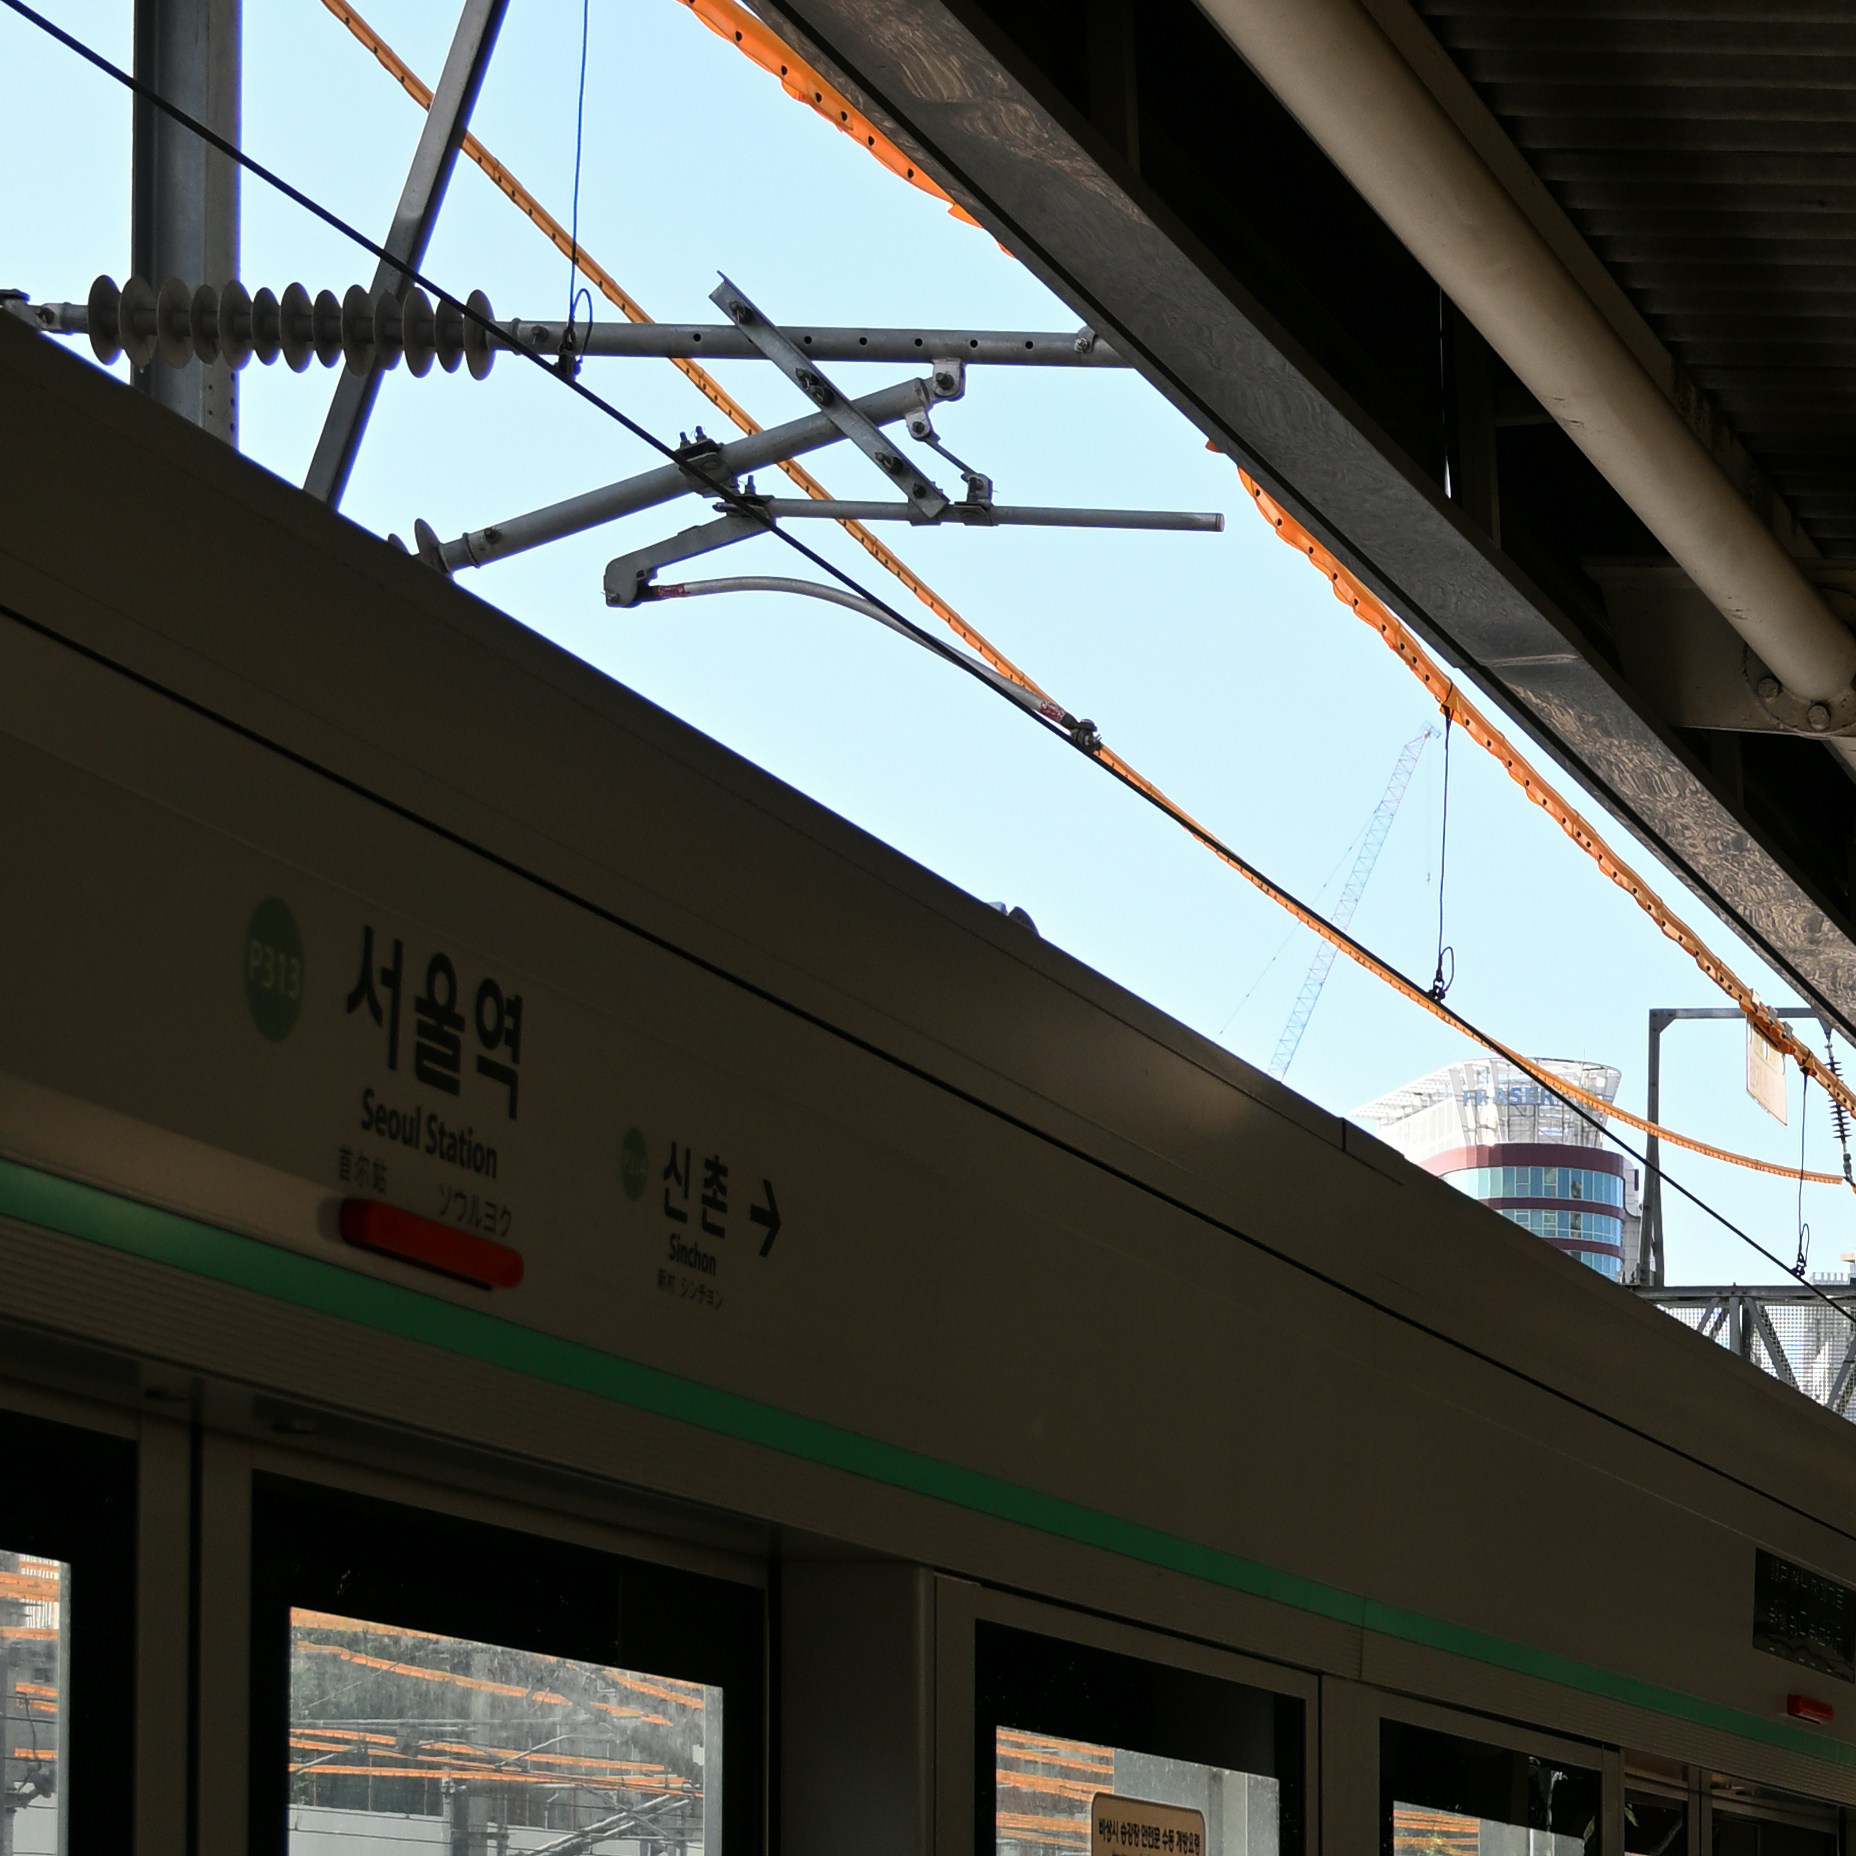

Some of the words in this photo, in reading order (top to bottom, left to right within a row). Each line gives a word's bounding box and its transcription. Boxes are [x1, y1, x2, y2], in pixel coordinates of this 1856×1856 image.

[249, 939, 302, 1000] P313
[346, 924, 523, 1121] 서울역
[360, 1087, 422, 1150] Seoul
[425, 1109, 498, 1180] Station
[662, 1140, 730, 1239] 신촌
[669, 1234, 717, 1276] Sinchon
[1098, 1817, 1119, 1844] 비상시
